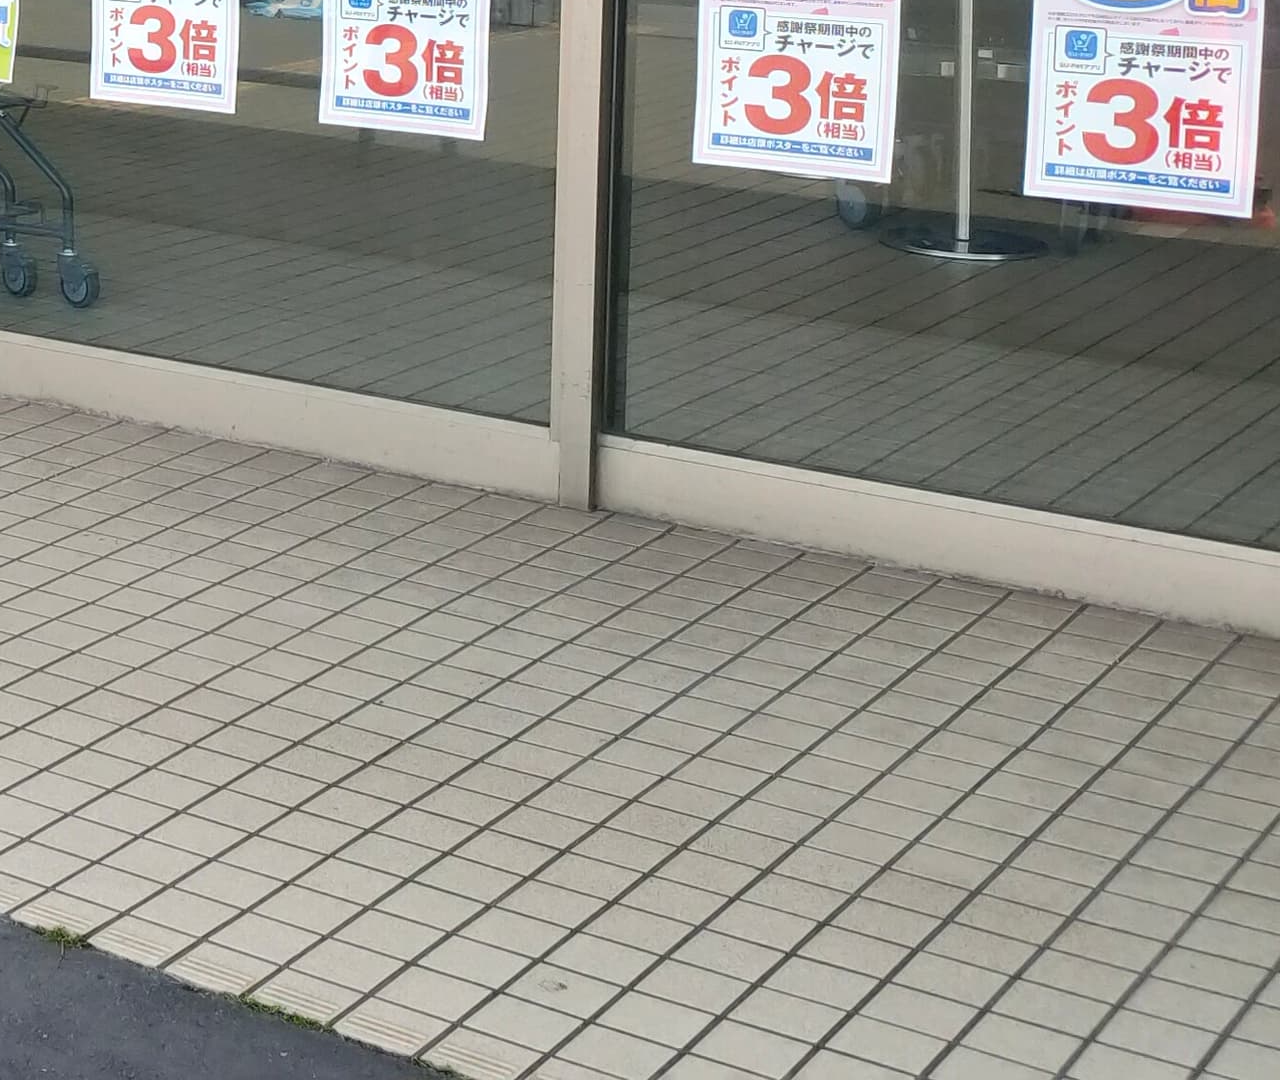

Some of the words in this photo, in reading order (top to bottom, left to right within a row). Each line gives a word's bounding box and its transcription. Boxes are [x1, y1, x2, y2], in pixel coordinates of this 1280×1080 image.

[386, 4, 470, 28] チャージで
[776, 20, 873, 39] 感謝祭期間中の
[109, 8, 124, 67] ポイント
[775, 34, 875, 60] チャージで
[1119, 42, 1230, 61] 感謝祭期間中の
[343, 25, 359, 90] ポイント
[1117, 56, 1233, 84] チャージで
[720, 56, 740, 127] ポイント
[1055, 80, 1078, 157] ポイント
